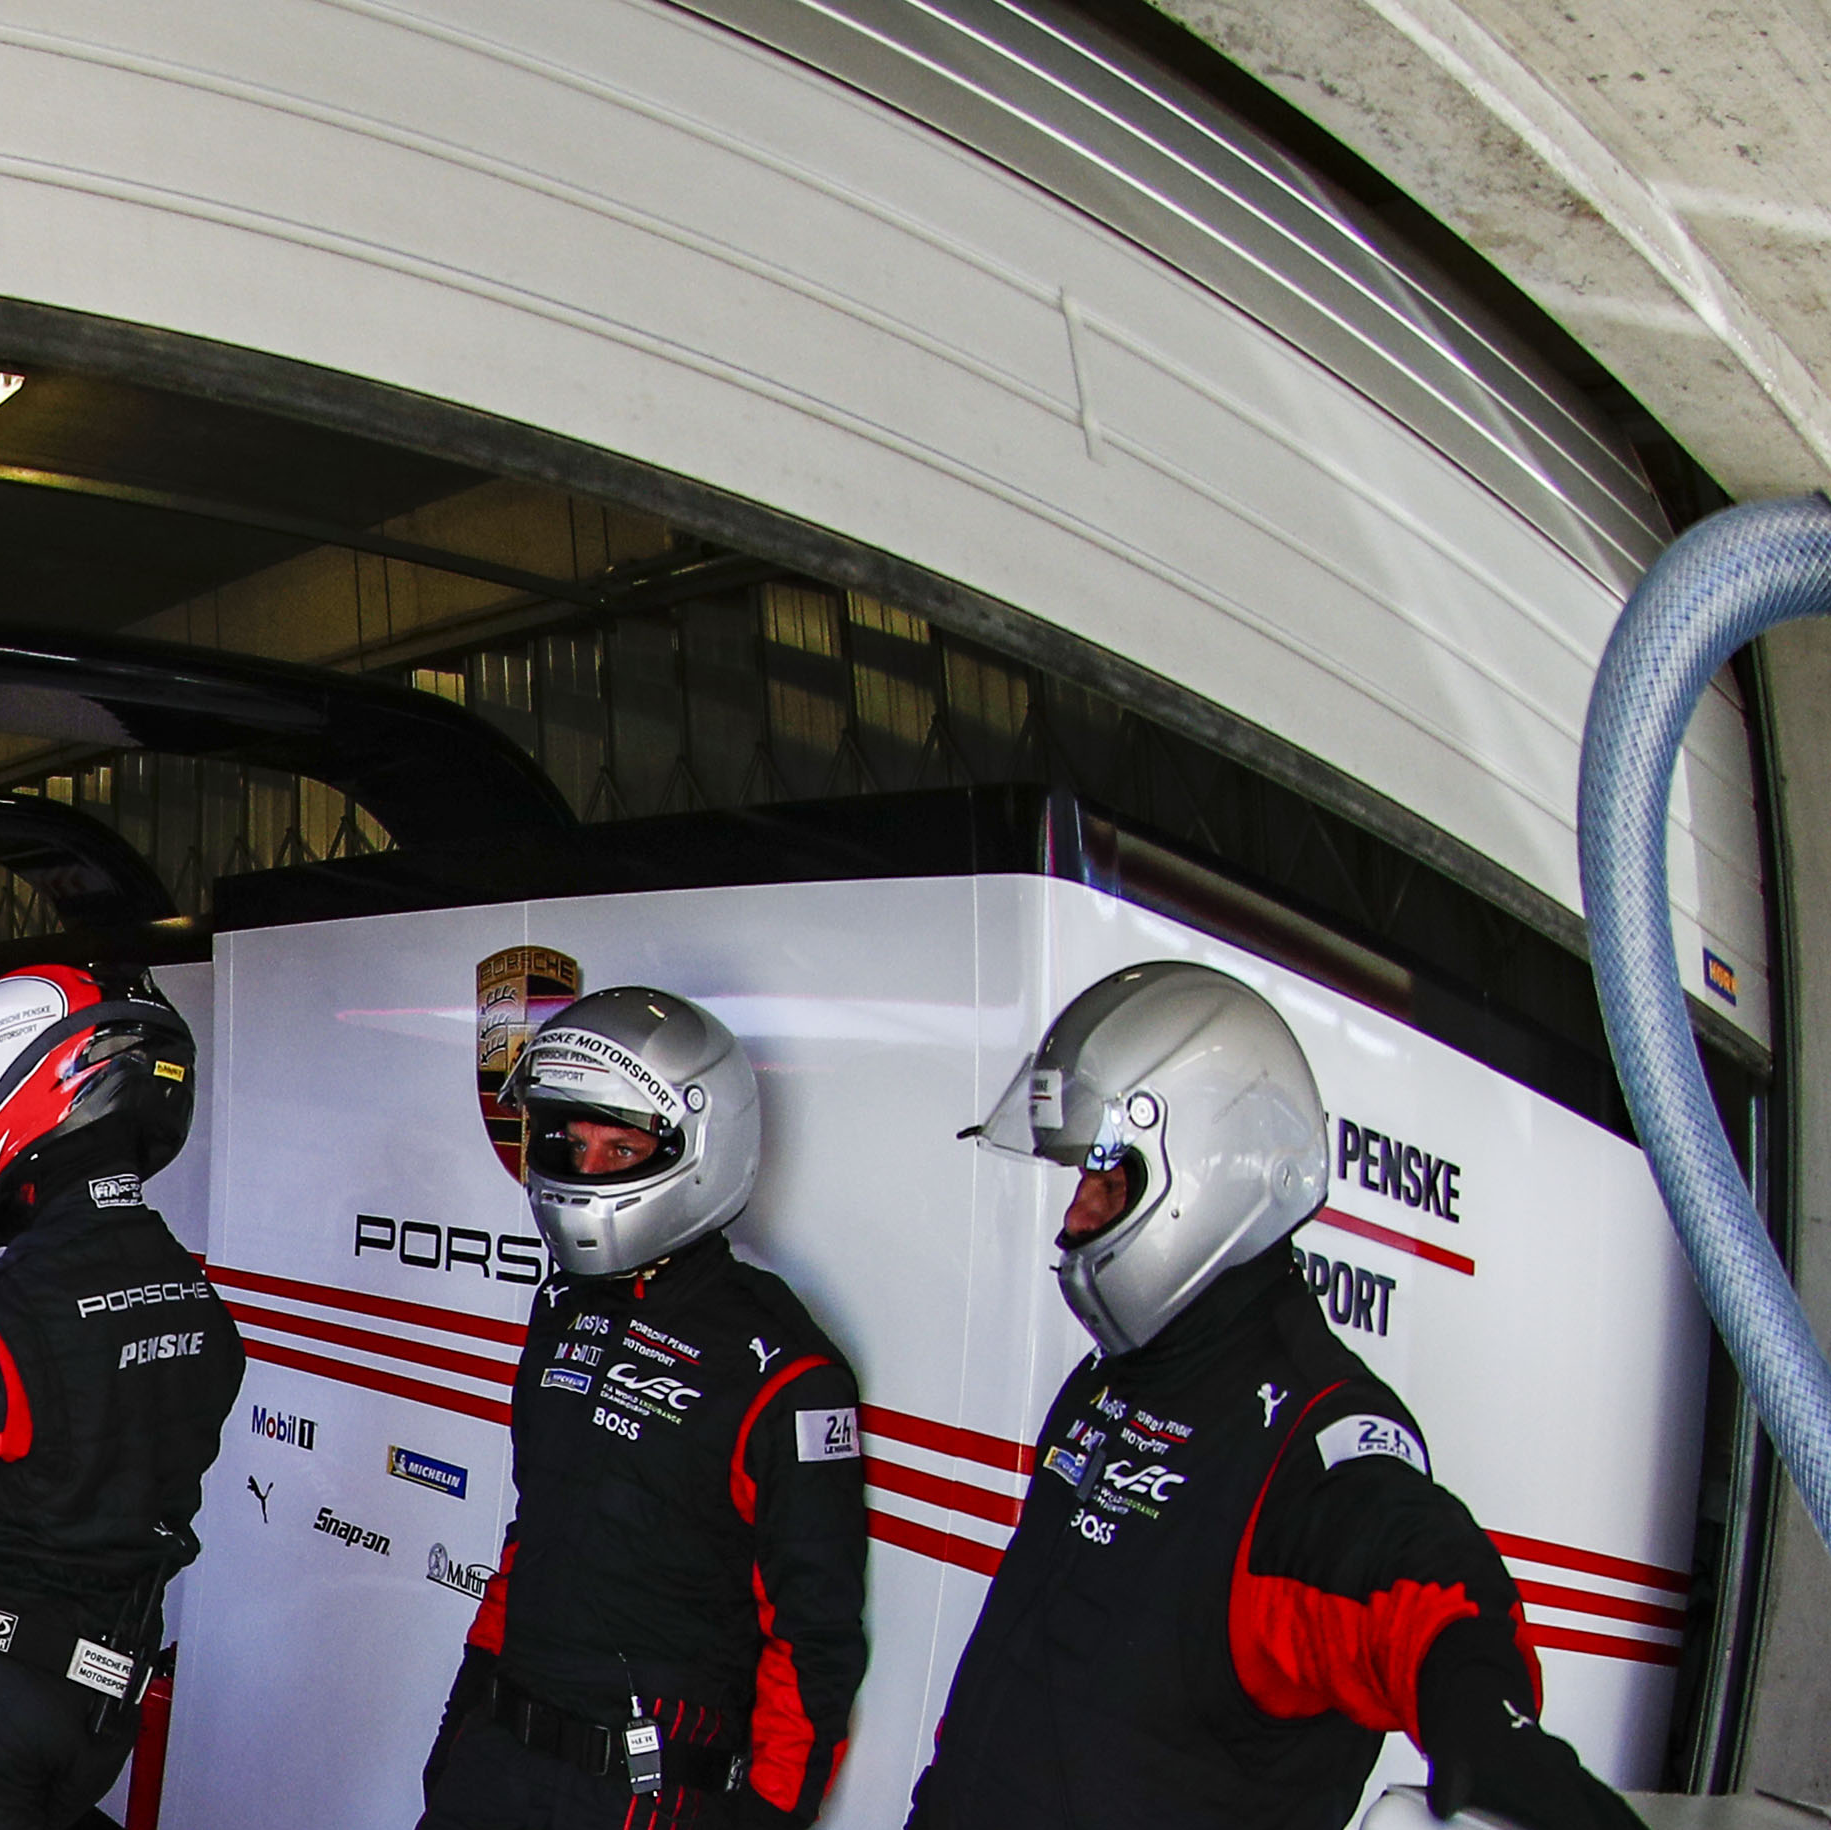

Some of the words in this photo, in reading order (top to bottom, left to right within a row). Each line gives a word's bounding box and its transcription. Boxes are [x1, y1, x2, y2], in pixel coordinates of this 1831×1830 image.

[480, 951, 574, 981] PORSCHE
[575, 1035, 677, 1113] MOTORSPORT
[1337, 1117, 1461, 1224] PENSKE
[355, 1214, 557, 1285] PORS
[77, 1282, 210, 1318] PORSCHE
[118, 1332, 204, 1370] PENSKE
[623, 1337, 675, 1367] MOTORSPORT
[629, 1319, 668, 1343] PORSCHE
[667, 1338, 701, 1359] PENSKE
[607, 1363, 701, 1410] WEC
[251, 1405, 296, 1445] Mobil
[593, 1407, 641, 1441] BOSS
[407, 1462, 461, 1489] MICHELIN
[313, 1507, 390, 1555] Snap-on
[85, 1650, 122, 1670] PORSCHE
